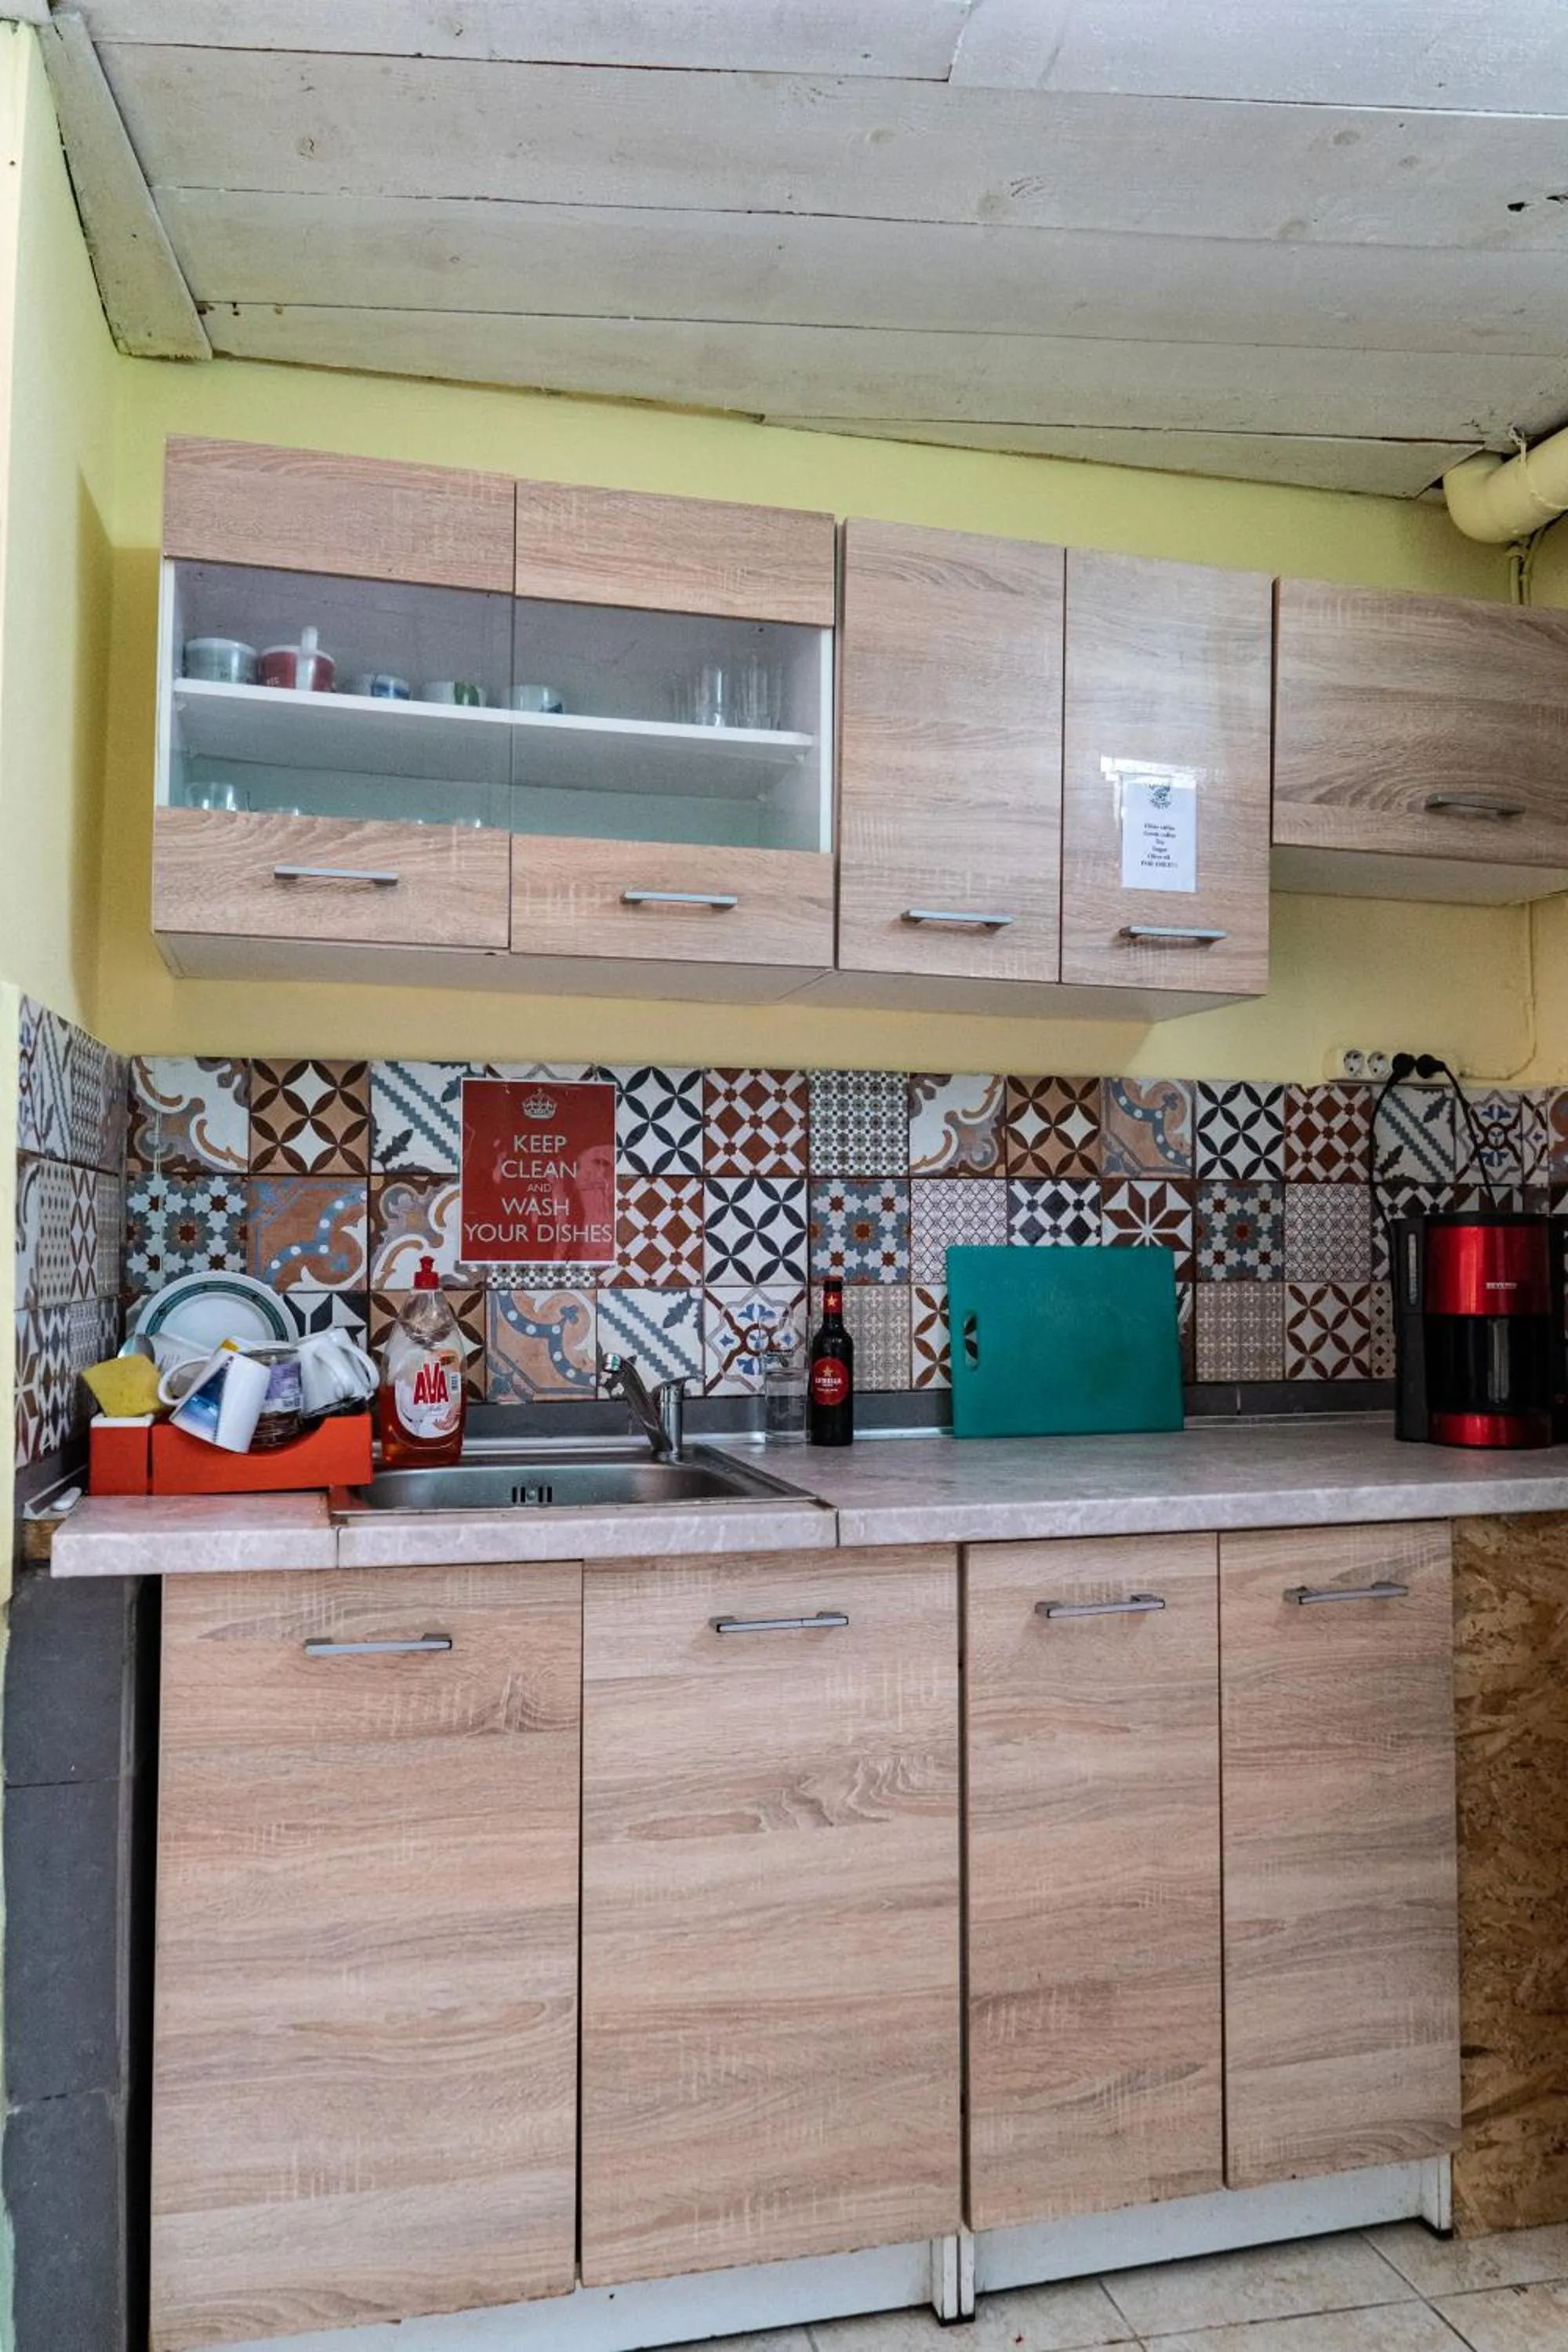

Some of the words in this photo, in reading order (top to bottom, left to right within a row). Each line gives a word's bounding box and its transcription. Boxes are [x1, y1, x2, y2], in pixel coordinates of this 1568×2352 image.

[514, 1134, 568, 1153] KEEP
[500, 1160, 578, 1178] CLEAN
[527, 1183, 552, 1192] AND
[501, 1197, 570, 1216] WASH
[463, 1223, 529, 1243] YOUR
[537, 1224, 613, 1243] DISHES
[413, 1362, 449, 1406] AVA
